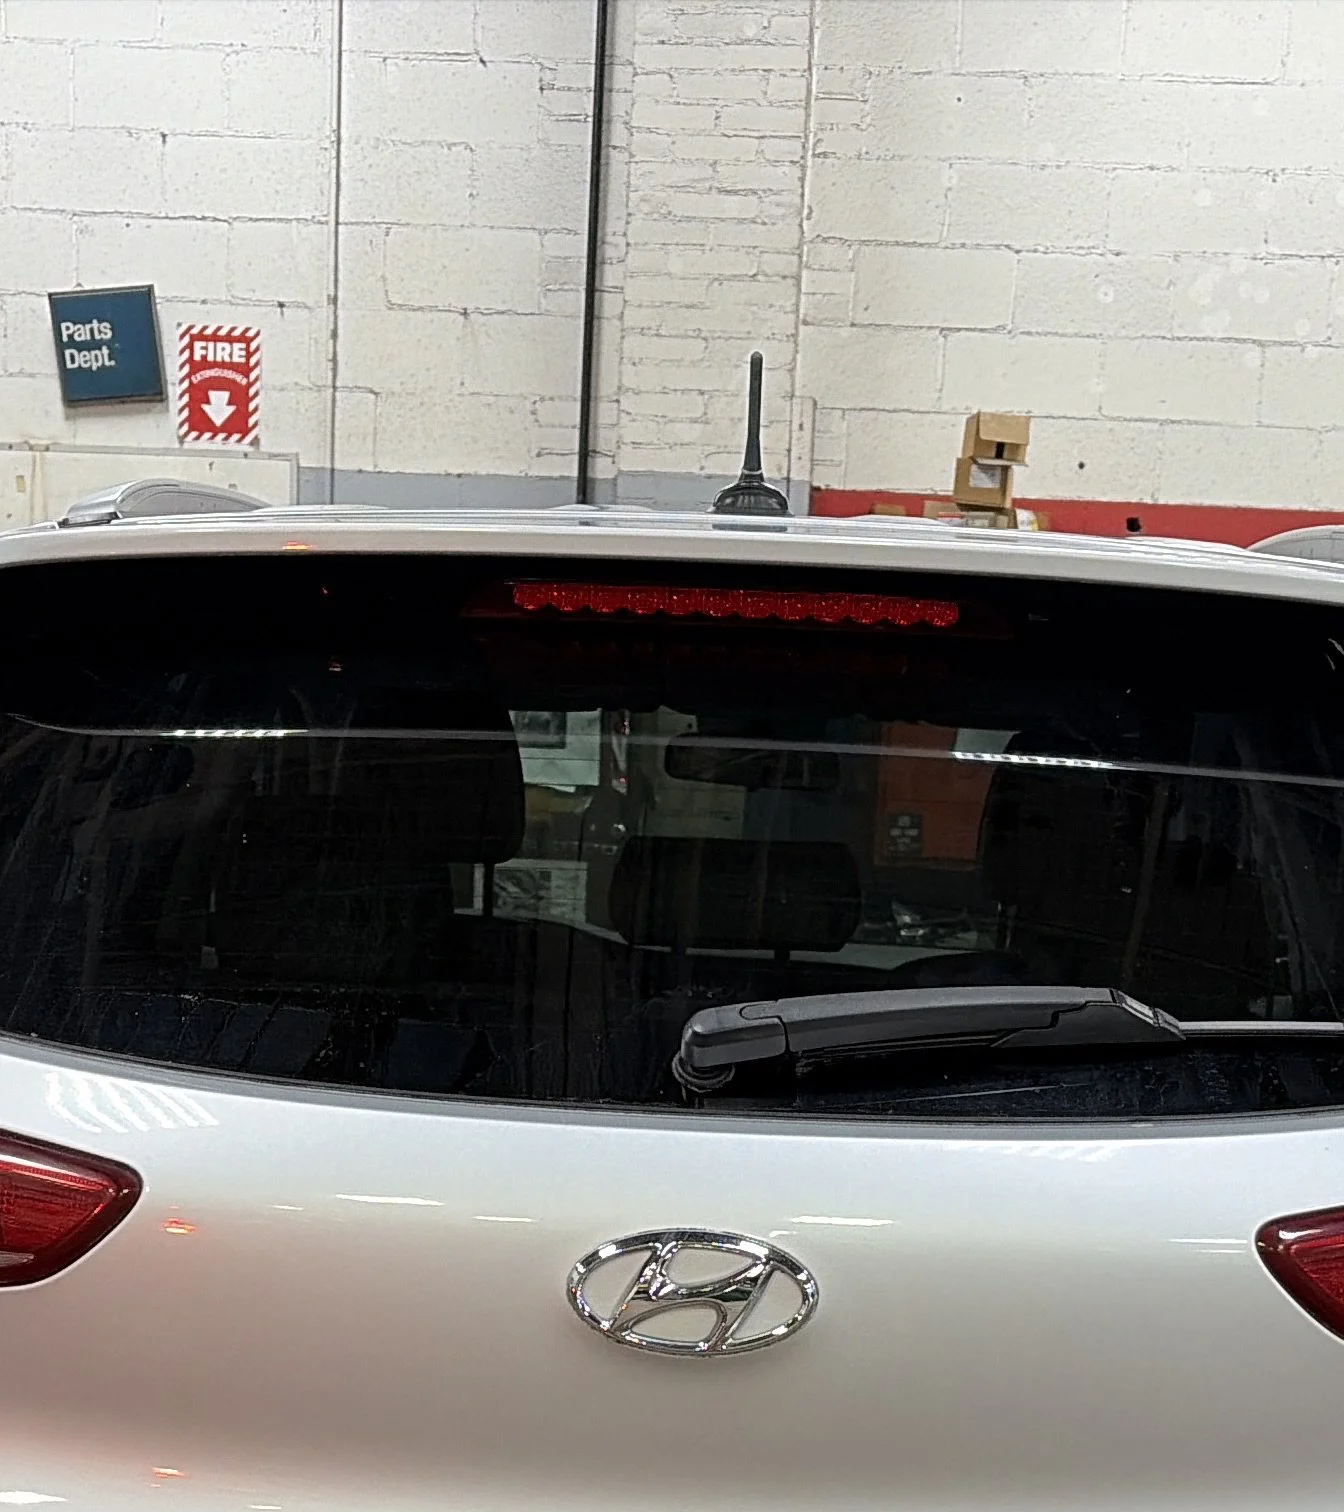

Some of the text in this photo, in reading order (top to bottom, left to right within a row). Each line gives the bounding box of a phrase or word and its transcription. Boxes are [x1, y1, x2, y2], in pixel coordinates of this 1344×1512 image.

[60, 319, 113, 342] Parts
[64, 345, 116, 371] Dept.
[193, 341, 247, 363] FIRE
